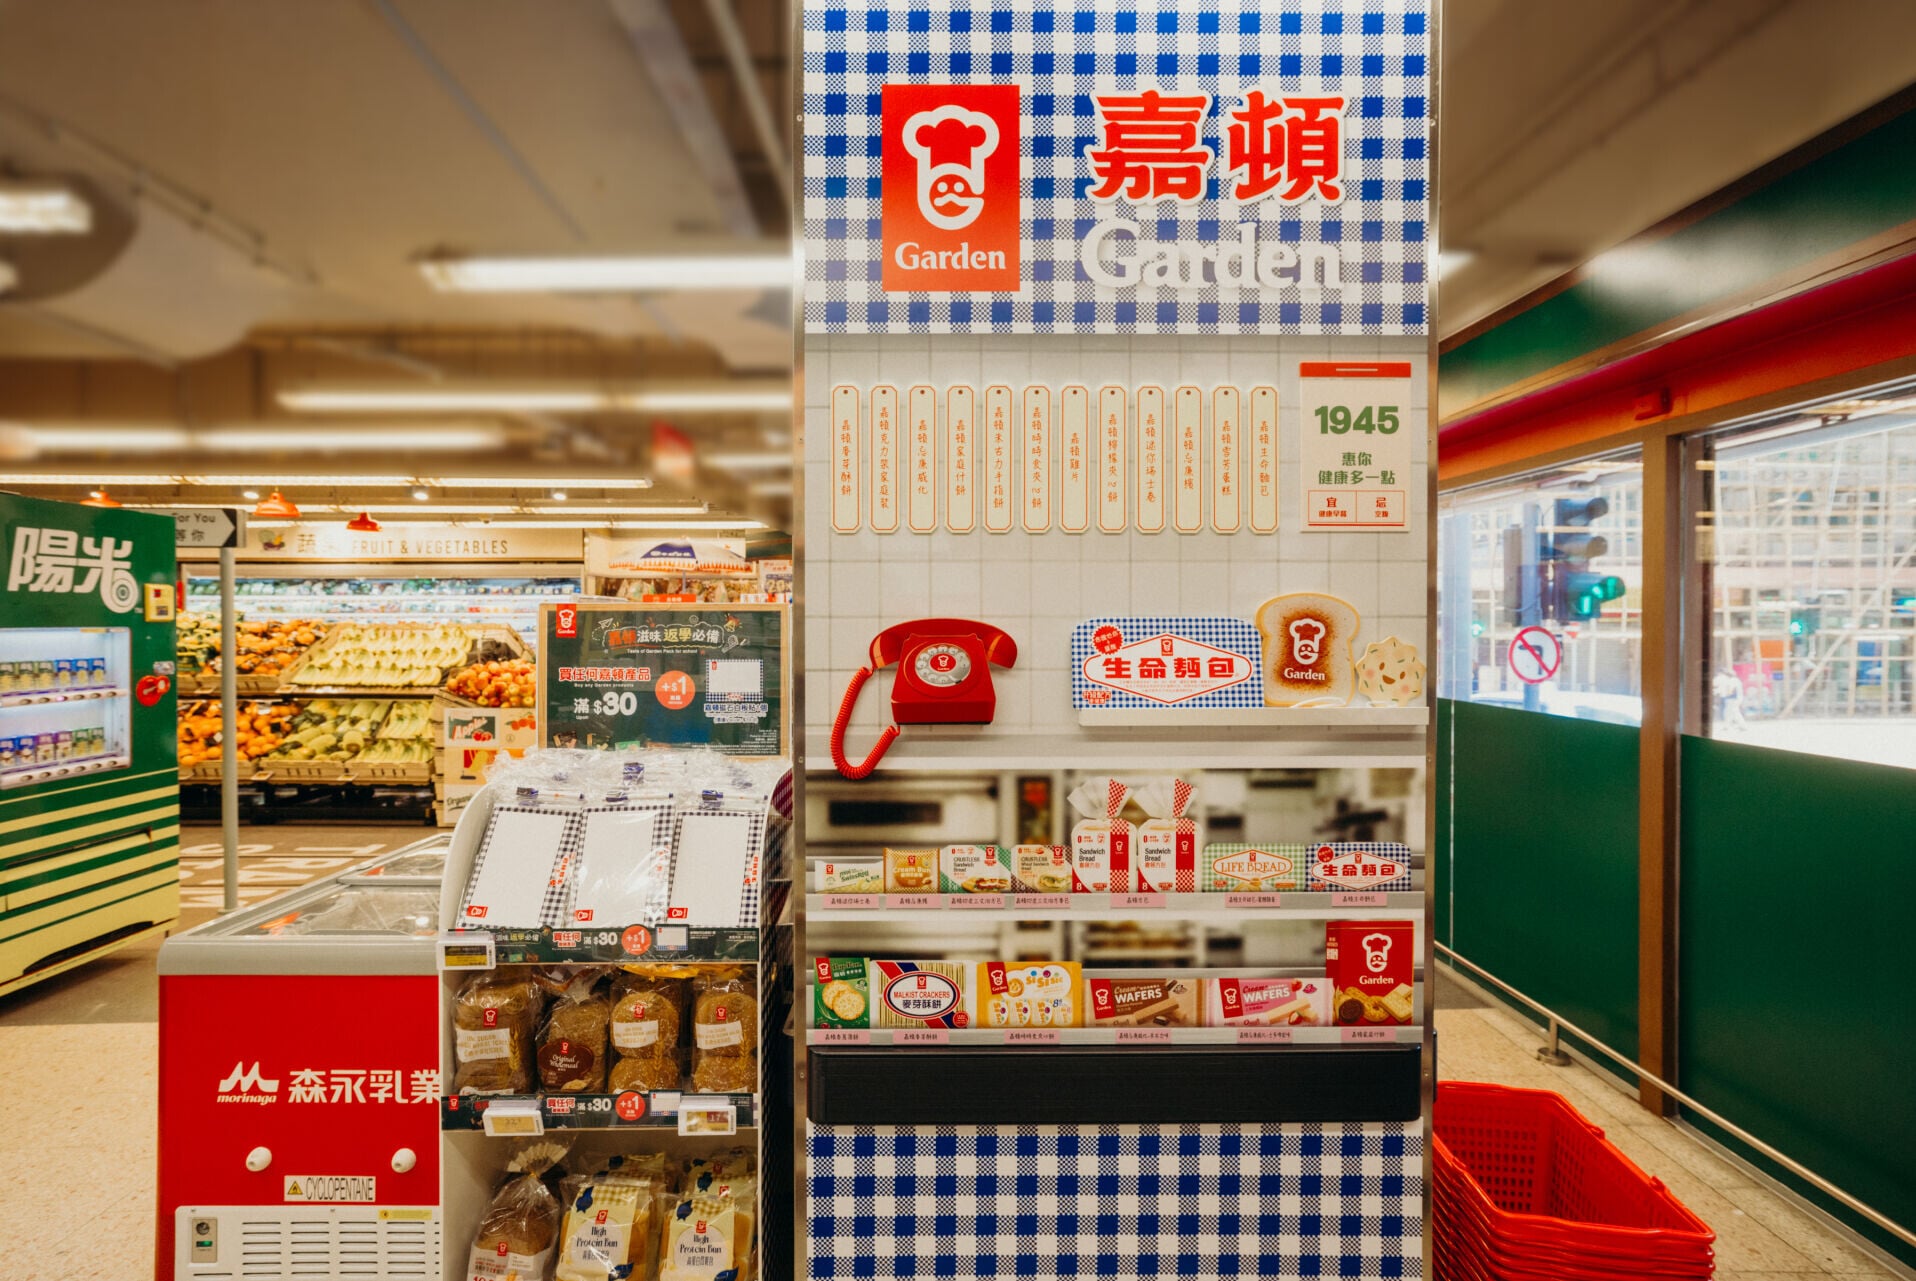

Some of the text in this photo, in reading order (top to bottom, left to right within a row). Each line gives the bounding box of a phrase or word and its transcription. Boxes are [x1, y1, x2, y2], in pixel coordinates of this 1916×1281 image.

[1088, 88, 1346, 203] 嘉頓
[894, 241, 1006, 271] Garden
[1081, 217, 1344, 290] Garden
[1314, 405, 1400, 435] 1945
[1342, 451, 1372, 466] 惠你
[1318, 470, 1396, 485] 健康多一點
[1326, 496, 1337, 508] 宜
[1376, 497, 1387, 508] 忌
[195, 513, 216, 523] You
[353, 540, 508, 554] FRUIT & VEGETABLES
[7, 526, 139, 614] 陽光
[559, 667, 651, 682] 買任何嘉頓產品
[1102, 656, 1235, 679] 生命麵包
[1284, 667, 1326, 682] Garden
[661, 675, 687, 695] +$1
[574, 691, 638, 716] 滿 $30
[1221, 862, 1287, 873] LIFE BREAD
[1322, 864, 1396, 877] 生命麵包
[1076, 882, 1082, 891] 8
[1142, 882, 1148, 891] 8
[593, 931, 618, 945] $30
[1359, 975, 1394, 985] Garden
[894, 991, 950, 999] MALKIST CRACKERS
[1114, 985, 1137, 995] Cream
[1115, 988, 1163, 1004] WAFERS
[1242, 984, 1265, 994] Cream
[1243, 987, 1291, 1003] WAFERS
[549, 1060, 580, 1069] Wholemeal
[552, 1054, 576, 1063] Original
[288, 1068, 441, 1104] 森永乳業
[217, 1094, 277, 1106] morinaga
[547, 1097, 576, 1109] 買任何
[587, 1098, 612, 1112] $30
[620, 1095, 639, 1110] +$1
[306, 1177, 373, 1201] CYCLOPENTANE
[591, 1226, 607, 1237] High
[576, 1237, 618, 1247] Protein Bun
[693, 1234, 709, 1245] High
[679, 1243, 722, 1254] Protein Bun
